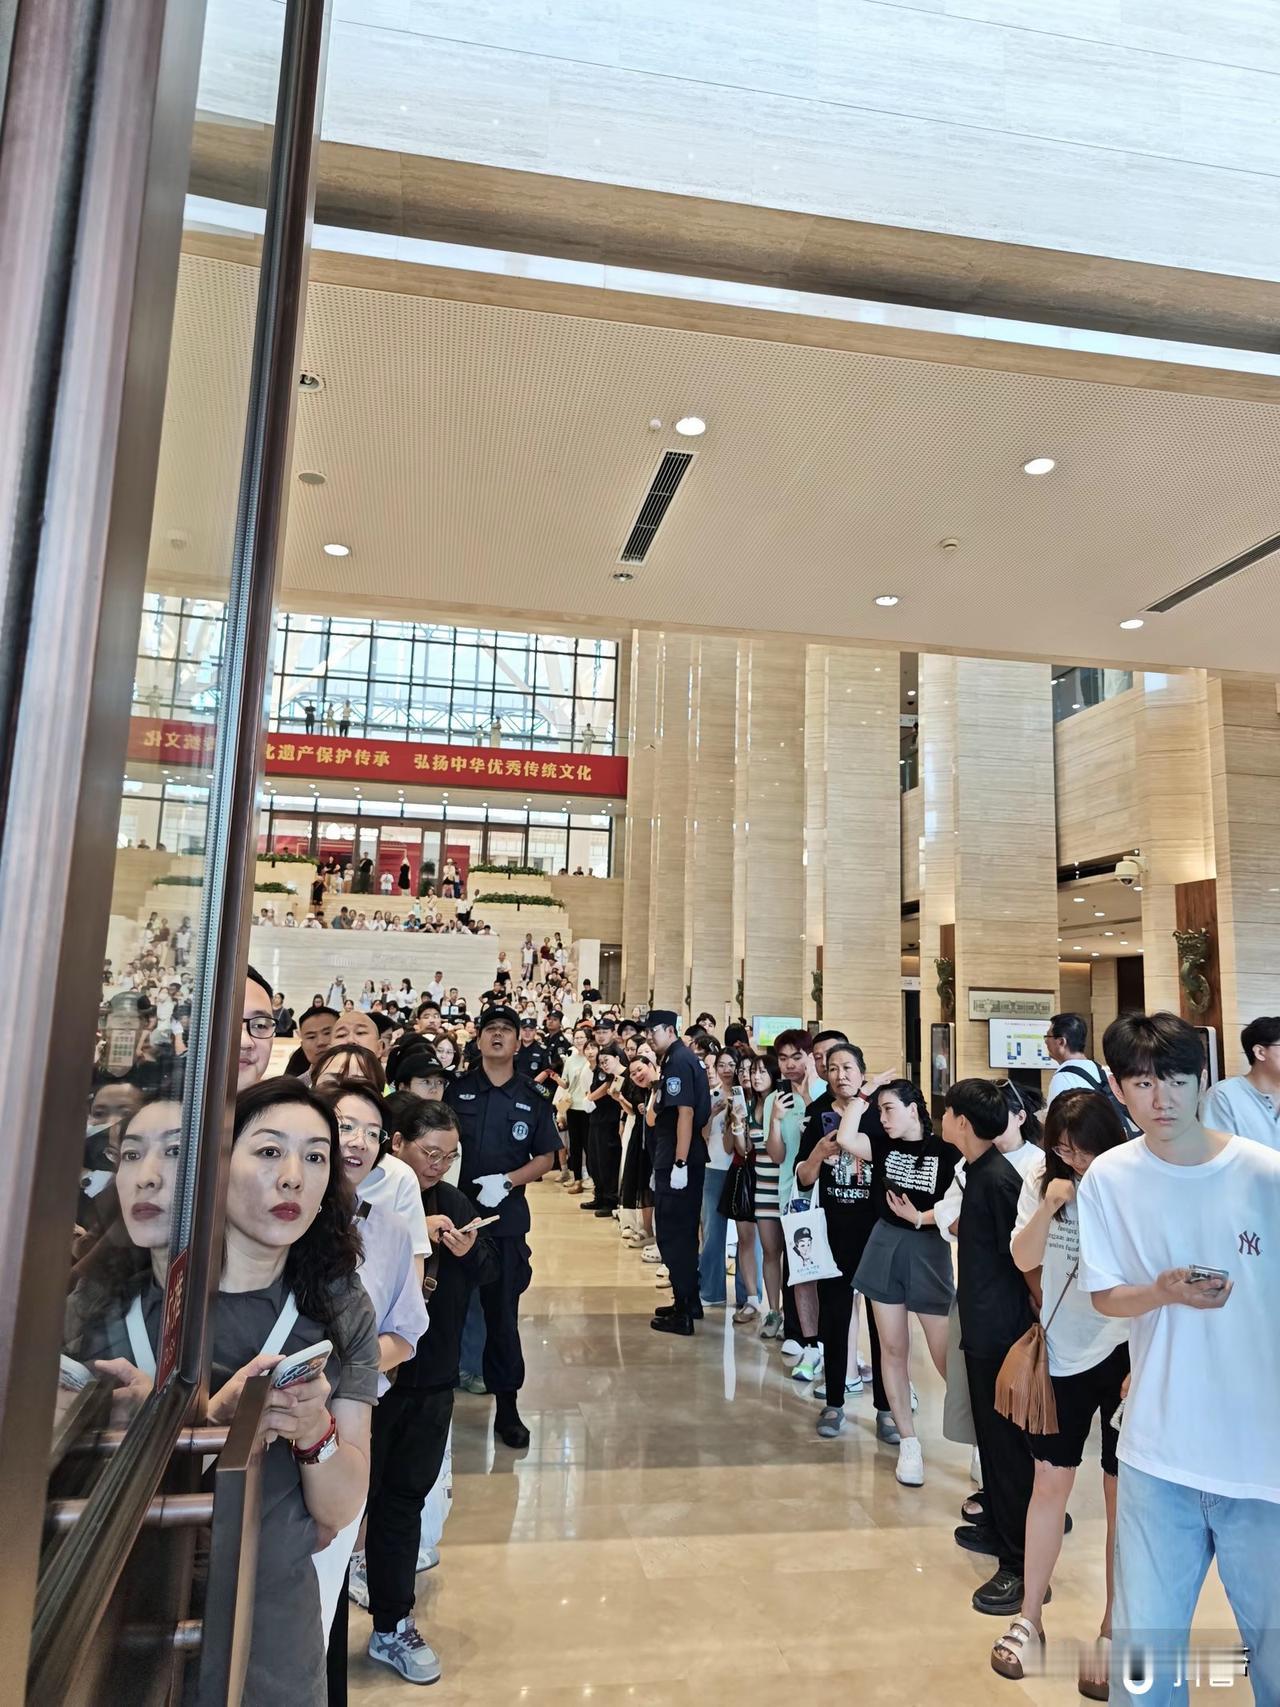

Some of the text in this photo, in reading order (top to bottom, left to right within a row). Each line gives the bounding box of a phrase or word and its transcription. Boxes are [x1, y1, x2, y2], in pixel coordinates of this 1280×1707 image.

[414, 753, 592, 781] 弘扬中华优秀传统文化
[1238, 1230, 1261, 1256] NY
